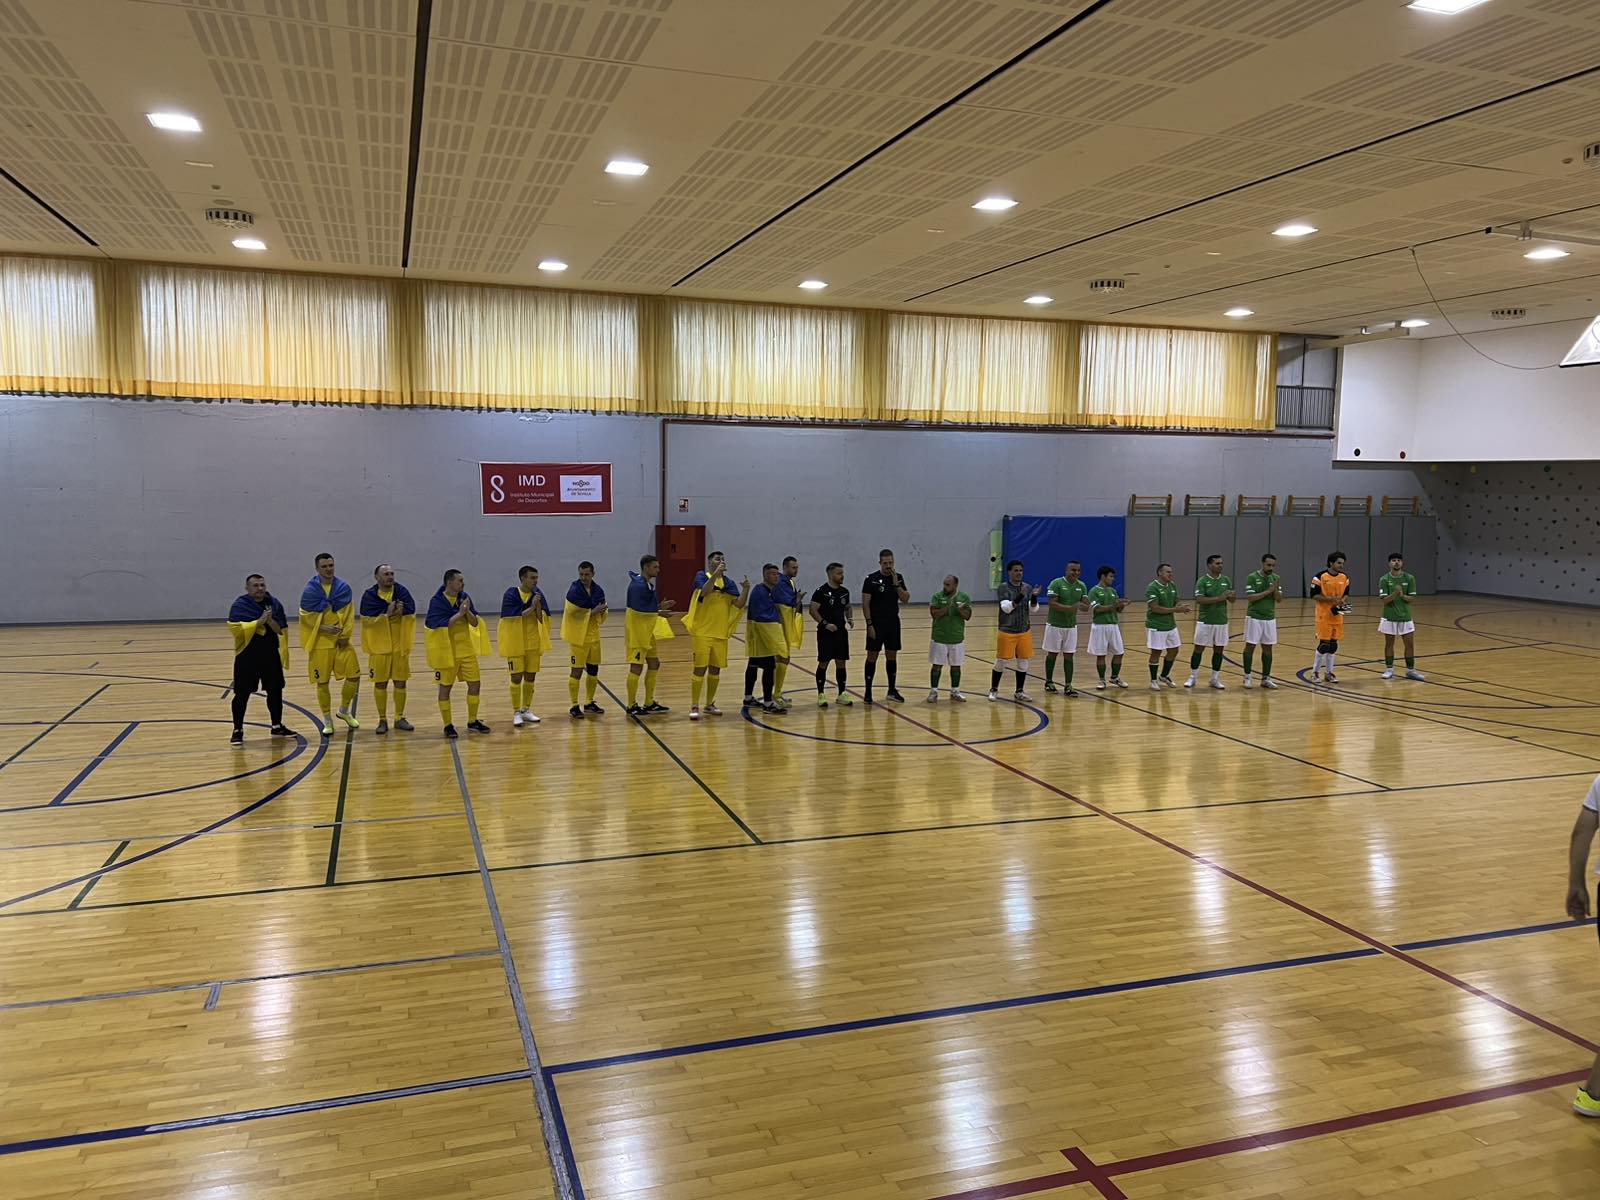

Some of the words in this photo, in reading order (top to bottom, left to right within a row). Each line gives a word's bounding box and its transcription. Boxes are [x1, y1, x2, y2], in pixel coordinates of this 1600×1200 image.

[518, 475, 546, 486] IMD
[634, 652, 641, 661] 4
[313, 669, 320, 680] 3
[434, 671, 441, 681] 9
